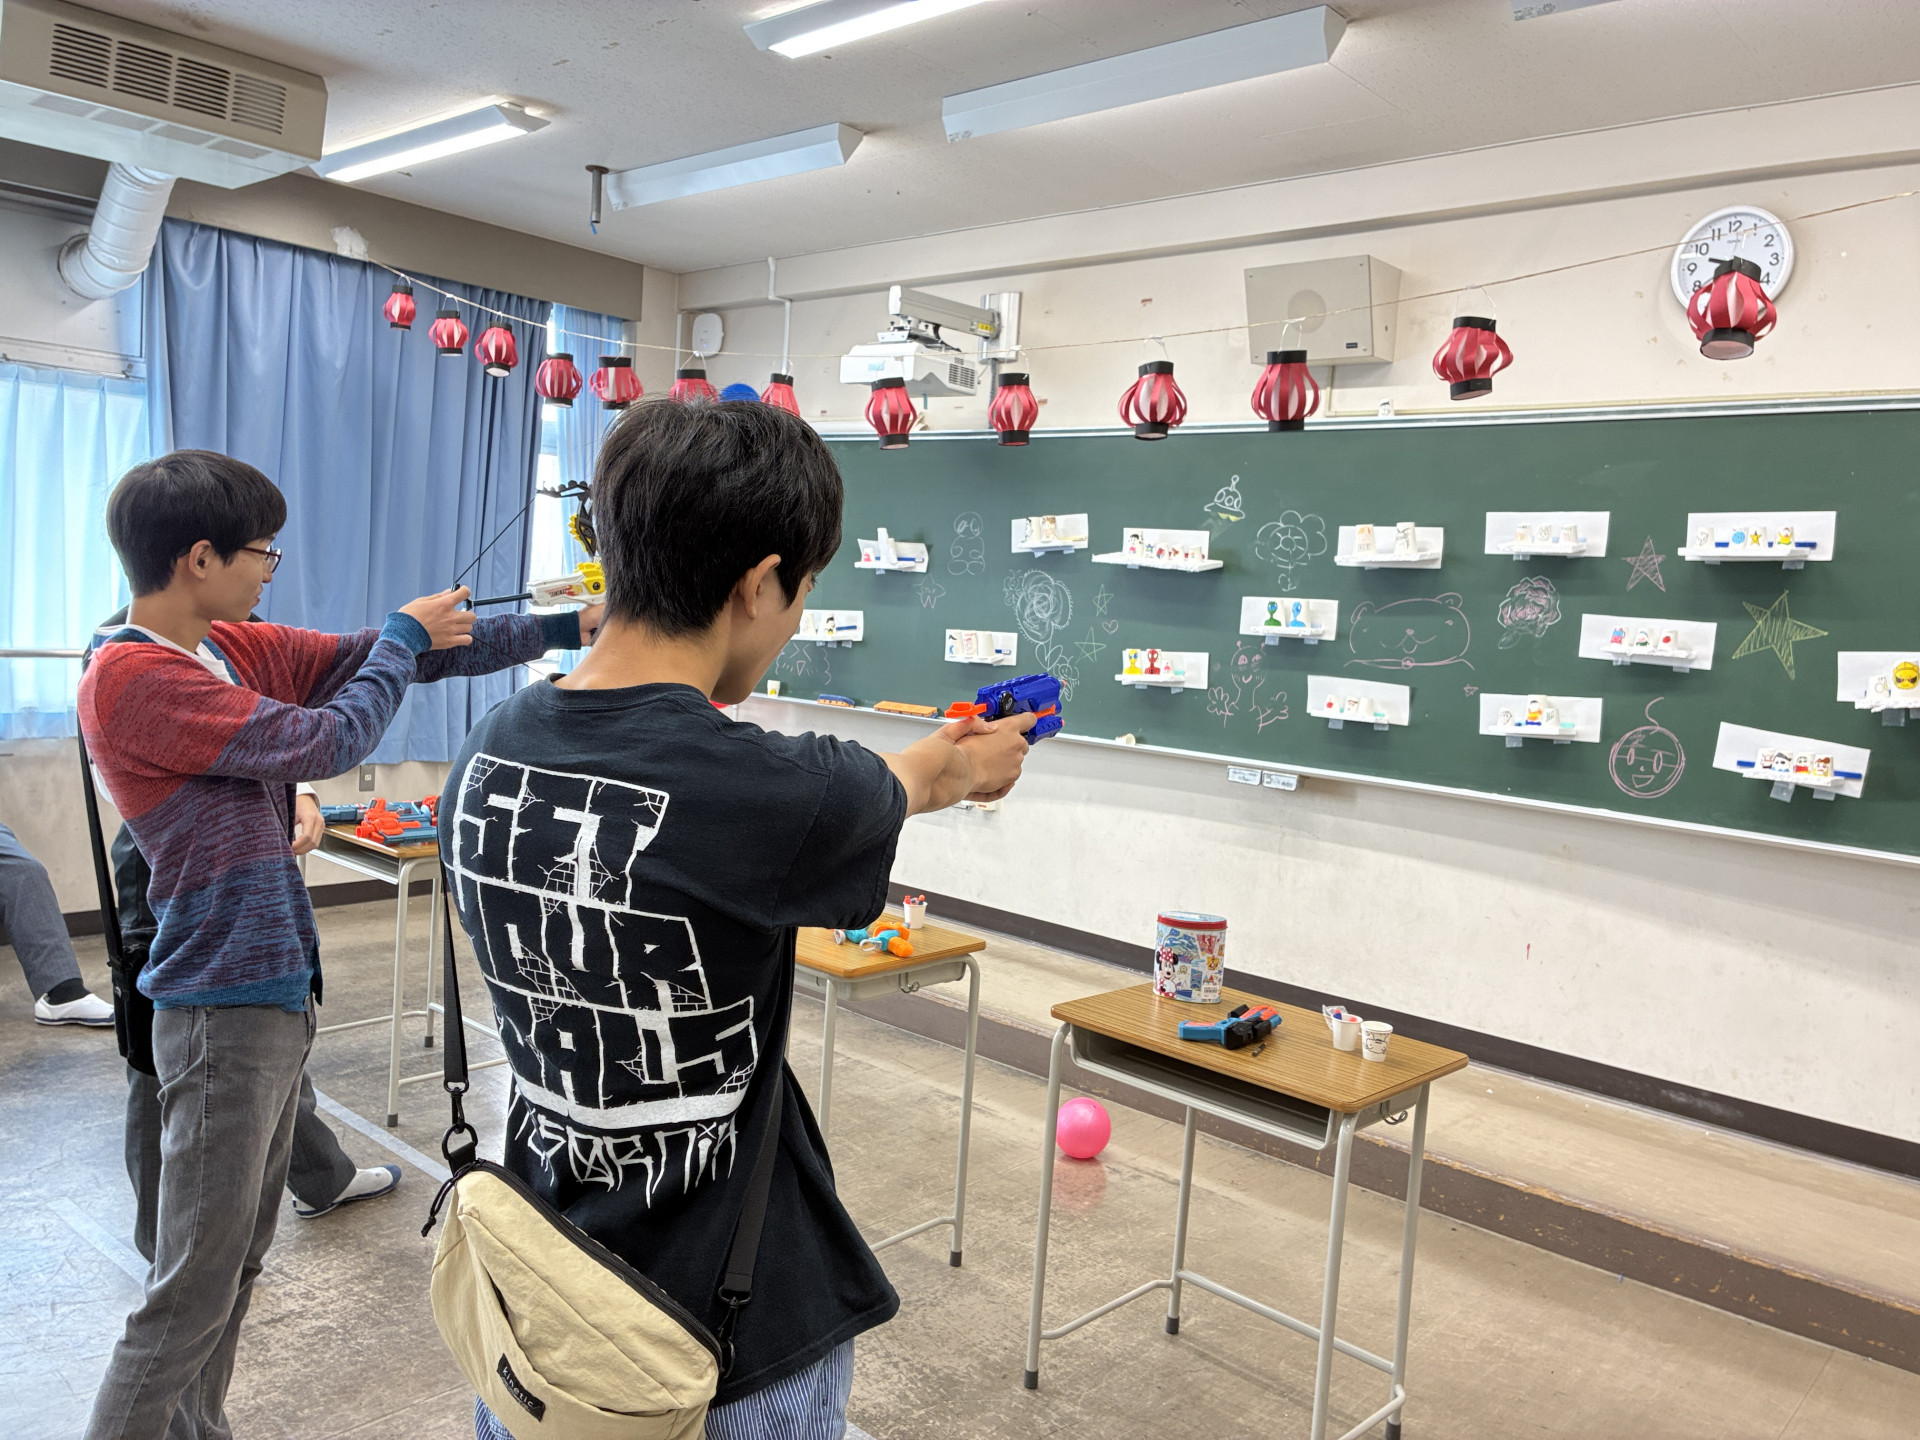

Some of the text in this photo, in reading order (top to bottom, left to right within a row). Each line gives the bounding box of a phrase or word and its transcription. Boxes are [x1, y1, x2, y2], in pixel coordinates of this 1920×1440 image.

[1728, 220, 1742, 233] 12
[1712, 228, 1721, 241] 11
[1763, 234, 1774, 248] 2
[1695, 243, 1709, 256] 10
[1769, 252, 1780, 266] 3
[1687, 262, 1697, 276] 9
[1760, 272, 1771, 286] 4
[1692, 280, 1702, 293] 8
[502, 1366, 534, 1408] kinetic
